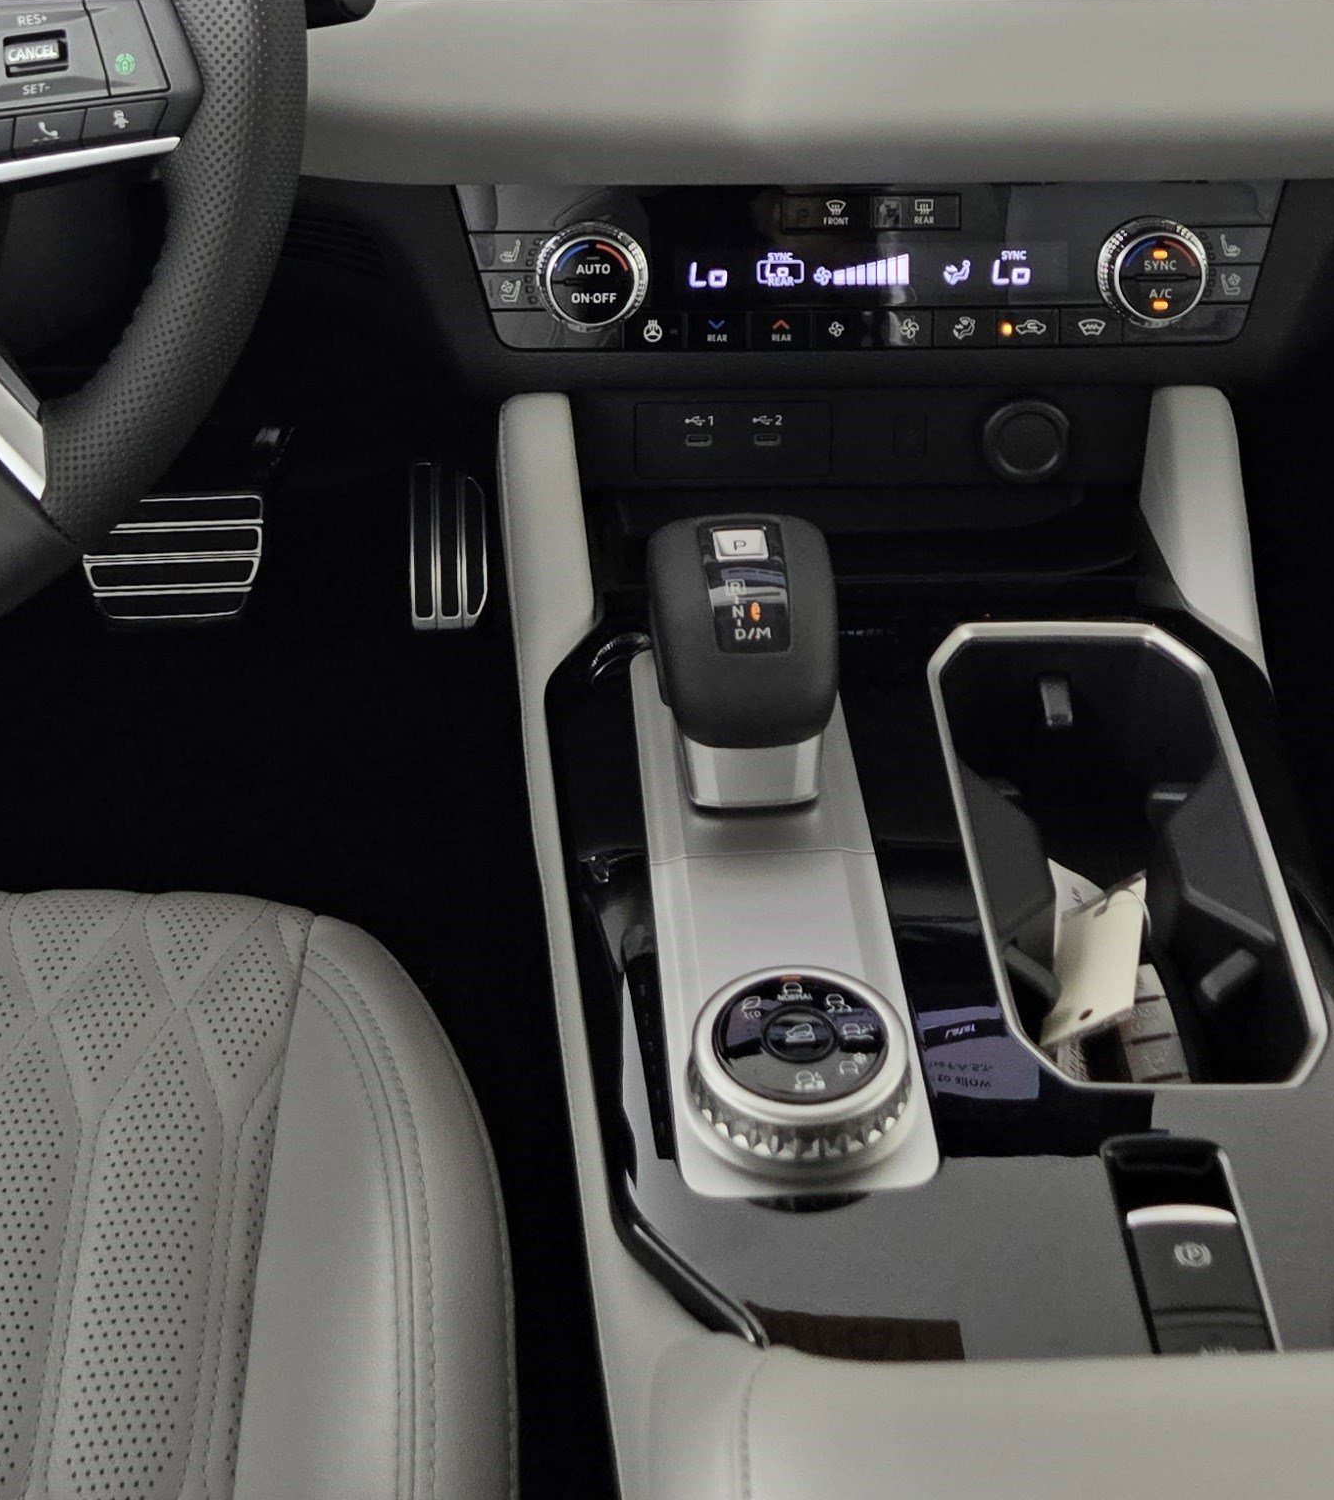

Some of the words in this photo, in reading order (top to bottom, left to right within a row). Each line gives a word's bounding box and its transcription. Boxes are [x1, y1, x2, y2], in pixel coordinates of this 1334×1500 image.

[16, 13, 49, 27] RES+
[6, 43, 59, 61] CANCEL
[21, 83, 51, 96] SET-
[823, 216, 849, 226] FRONT
[913, 216, 934, 225] REAR
[766, 252, 794, 261] SYNC
[1000, 249, 1028, 261] SYNC
[575, 263, 611, 276] AUTO
[1143, 260, 1178, 272] SYNC
[688, 261, 729, 288] Lo
[991, 259, 1032, 286] Lo
[767, 276, 795, 287] REAR
[1148, 288, 1173, 300] A/C
[706, 333, 728, 343] REAR
[771, 333, 792, 342] REAR
[707, 415, 715, 427] 1
[774, 414, 783, 426] 2
[733, 539, 747, 551] P
[729, 581, 742, 593] R
[732, 605, 745, 619] N
[734, 627, 772, 641] D/M
[776, 993, 813, 1002] NORMAL
